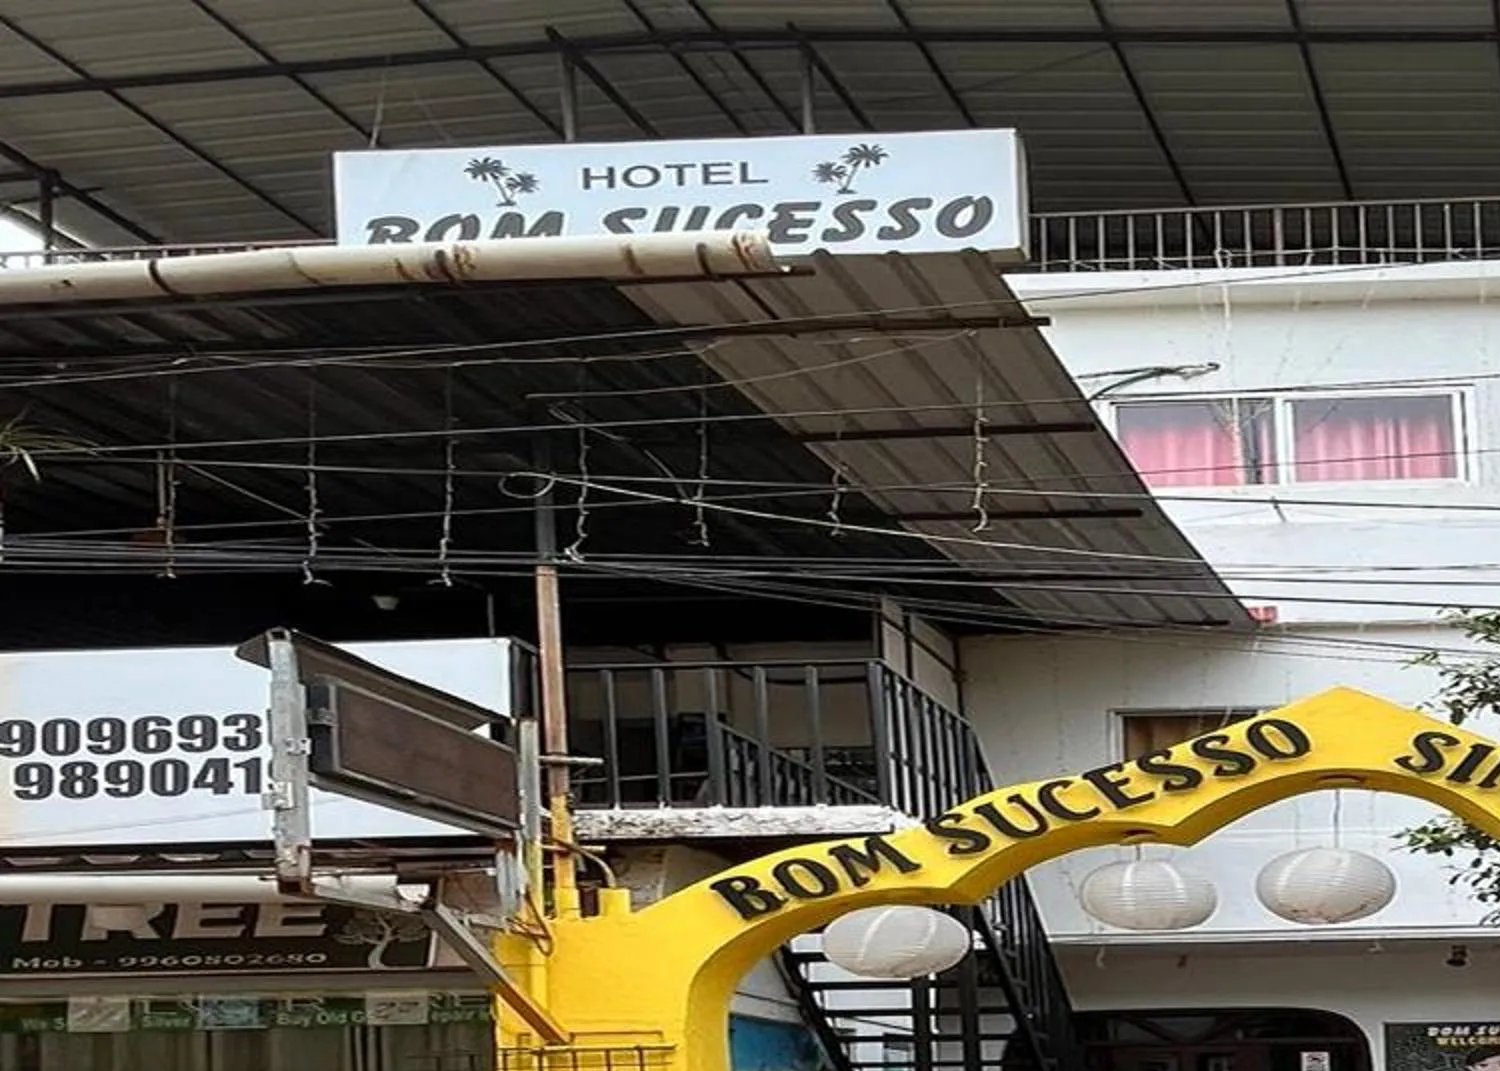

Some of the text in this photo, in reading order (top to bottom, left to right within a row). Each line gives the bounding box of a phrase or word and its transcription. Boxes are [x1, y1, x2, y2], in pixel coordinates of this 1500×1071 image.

[581, 161, 769, 191] HOTEL
[366, 195, 994, 244] BOM SUCESSO
[0, 713, 272, 758] 909693
[14, 756, 274, 800] 989041
[710, 834, 922, 921] BOM
[925, 719, 1312, 856] SUCESSO
[22, 902, 328, 942] TREE
[12, 956, 83, 969] Mob
